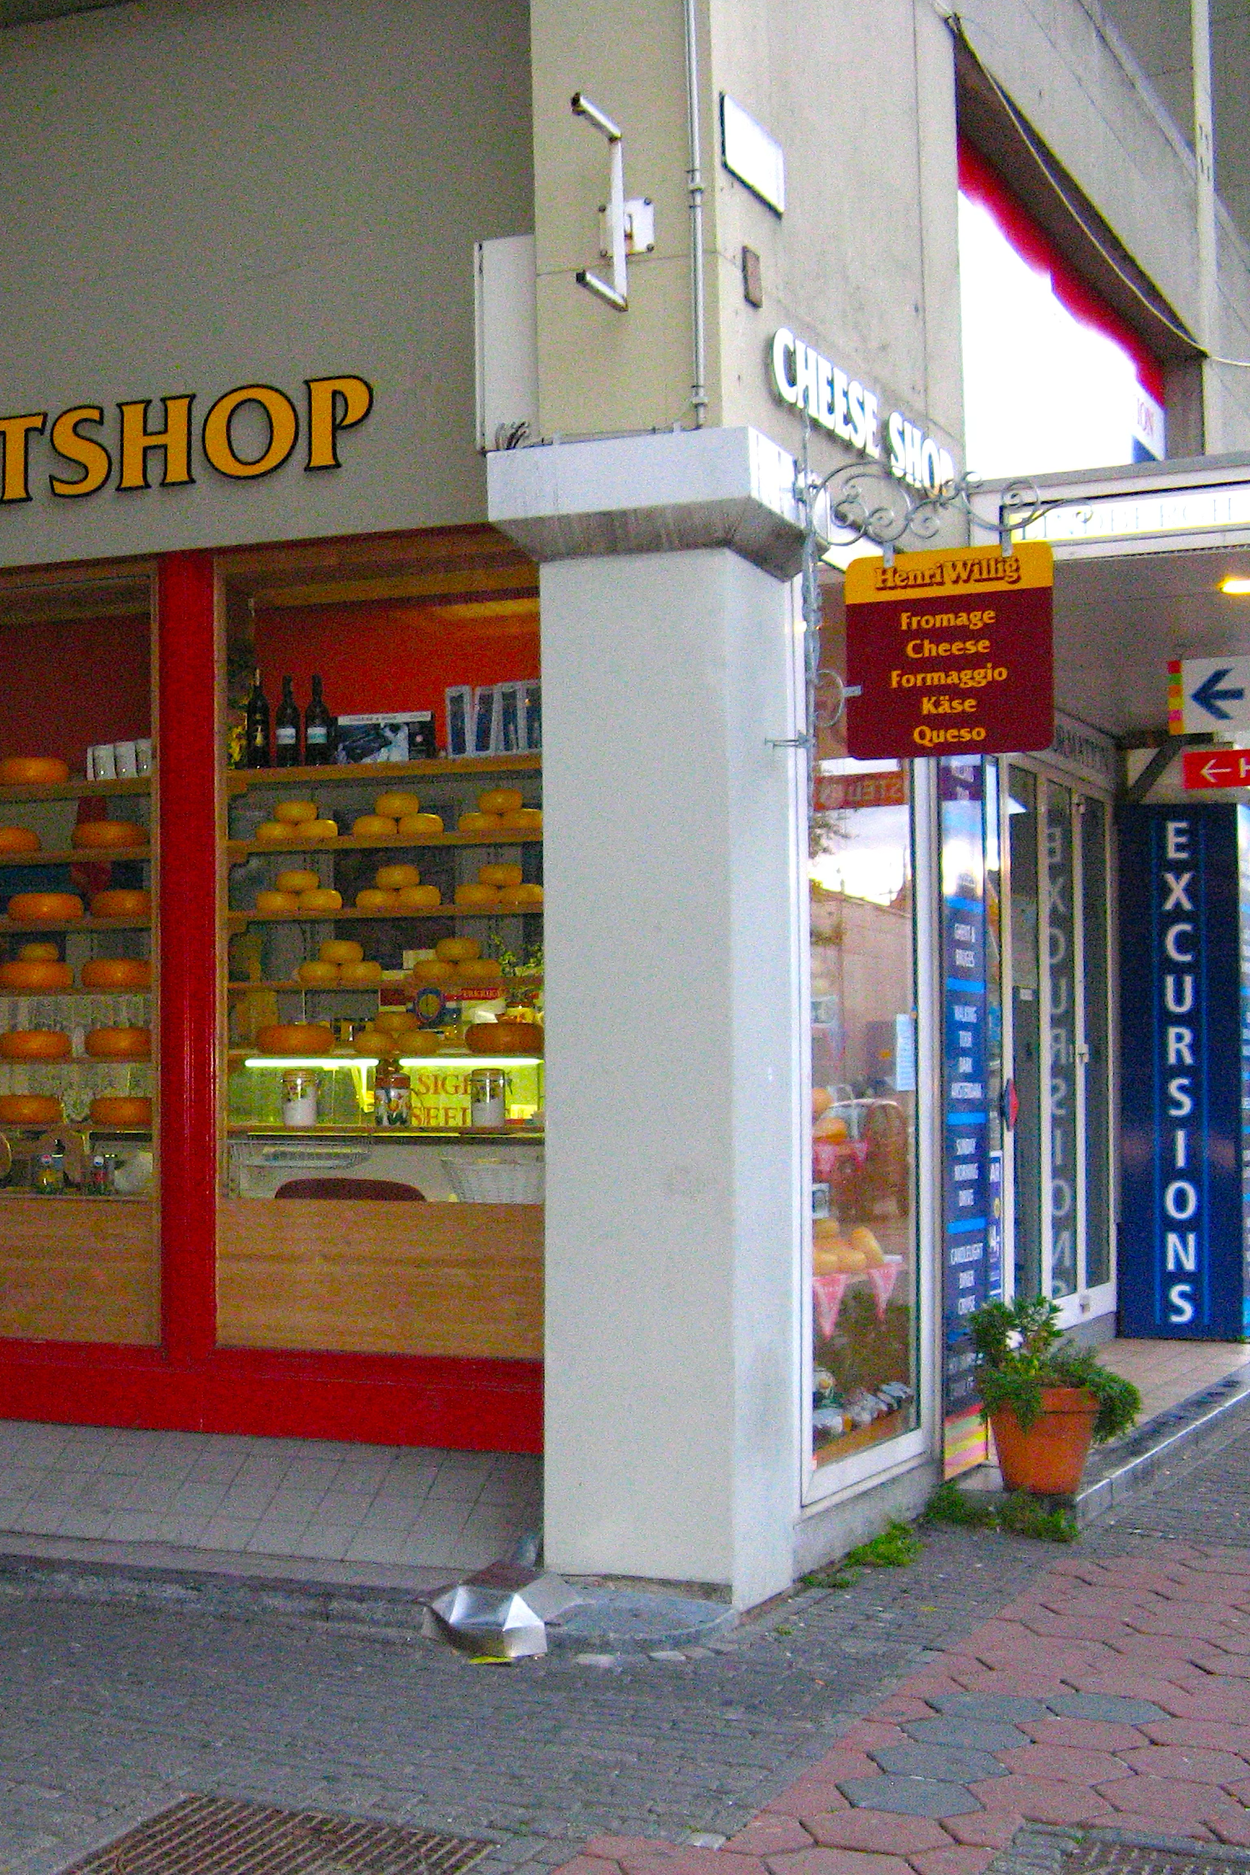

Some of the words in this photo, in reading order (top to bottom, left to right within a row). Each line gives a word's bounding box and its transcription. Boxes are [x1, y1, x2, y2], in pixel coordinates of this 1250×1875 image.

[773, 327, 880, 460] CHEESE
[889, 411, 956, 497] SHOP
[875, 562, 945, 591] Henri
[943, 556, 1022, 585] Willig
[900, 609, 997, 631] Fromage
[906, 638, 991, 659] Cheese
[890, 662, 1008, 689] Formaggio
[921, 695, 978, 715] Käse
[913, 725, 987, 747] Queso
[1162, 819, 1200, 1324] EXCURSIONS
